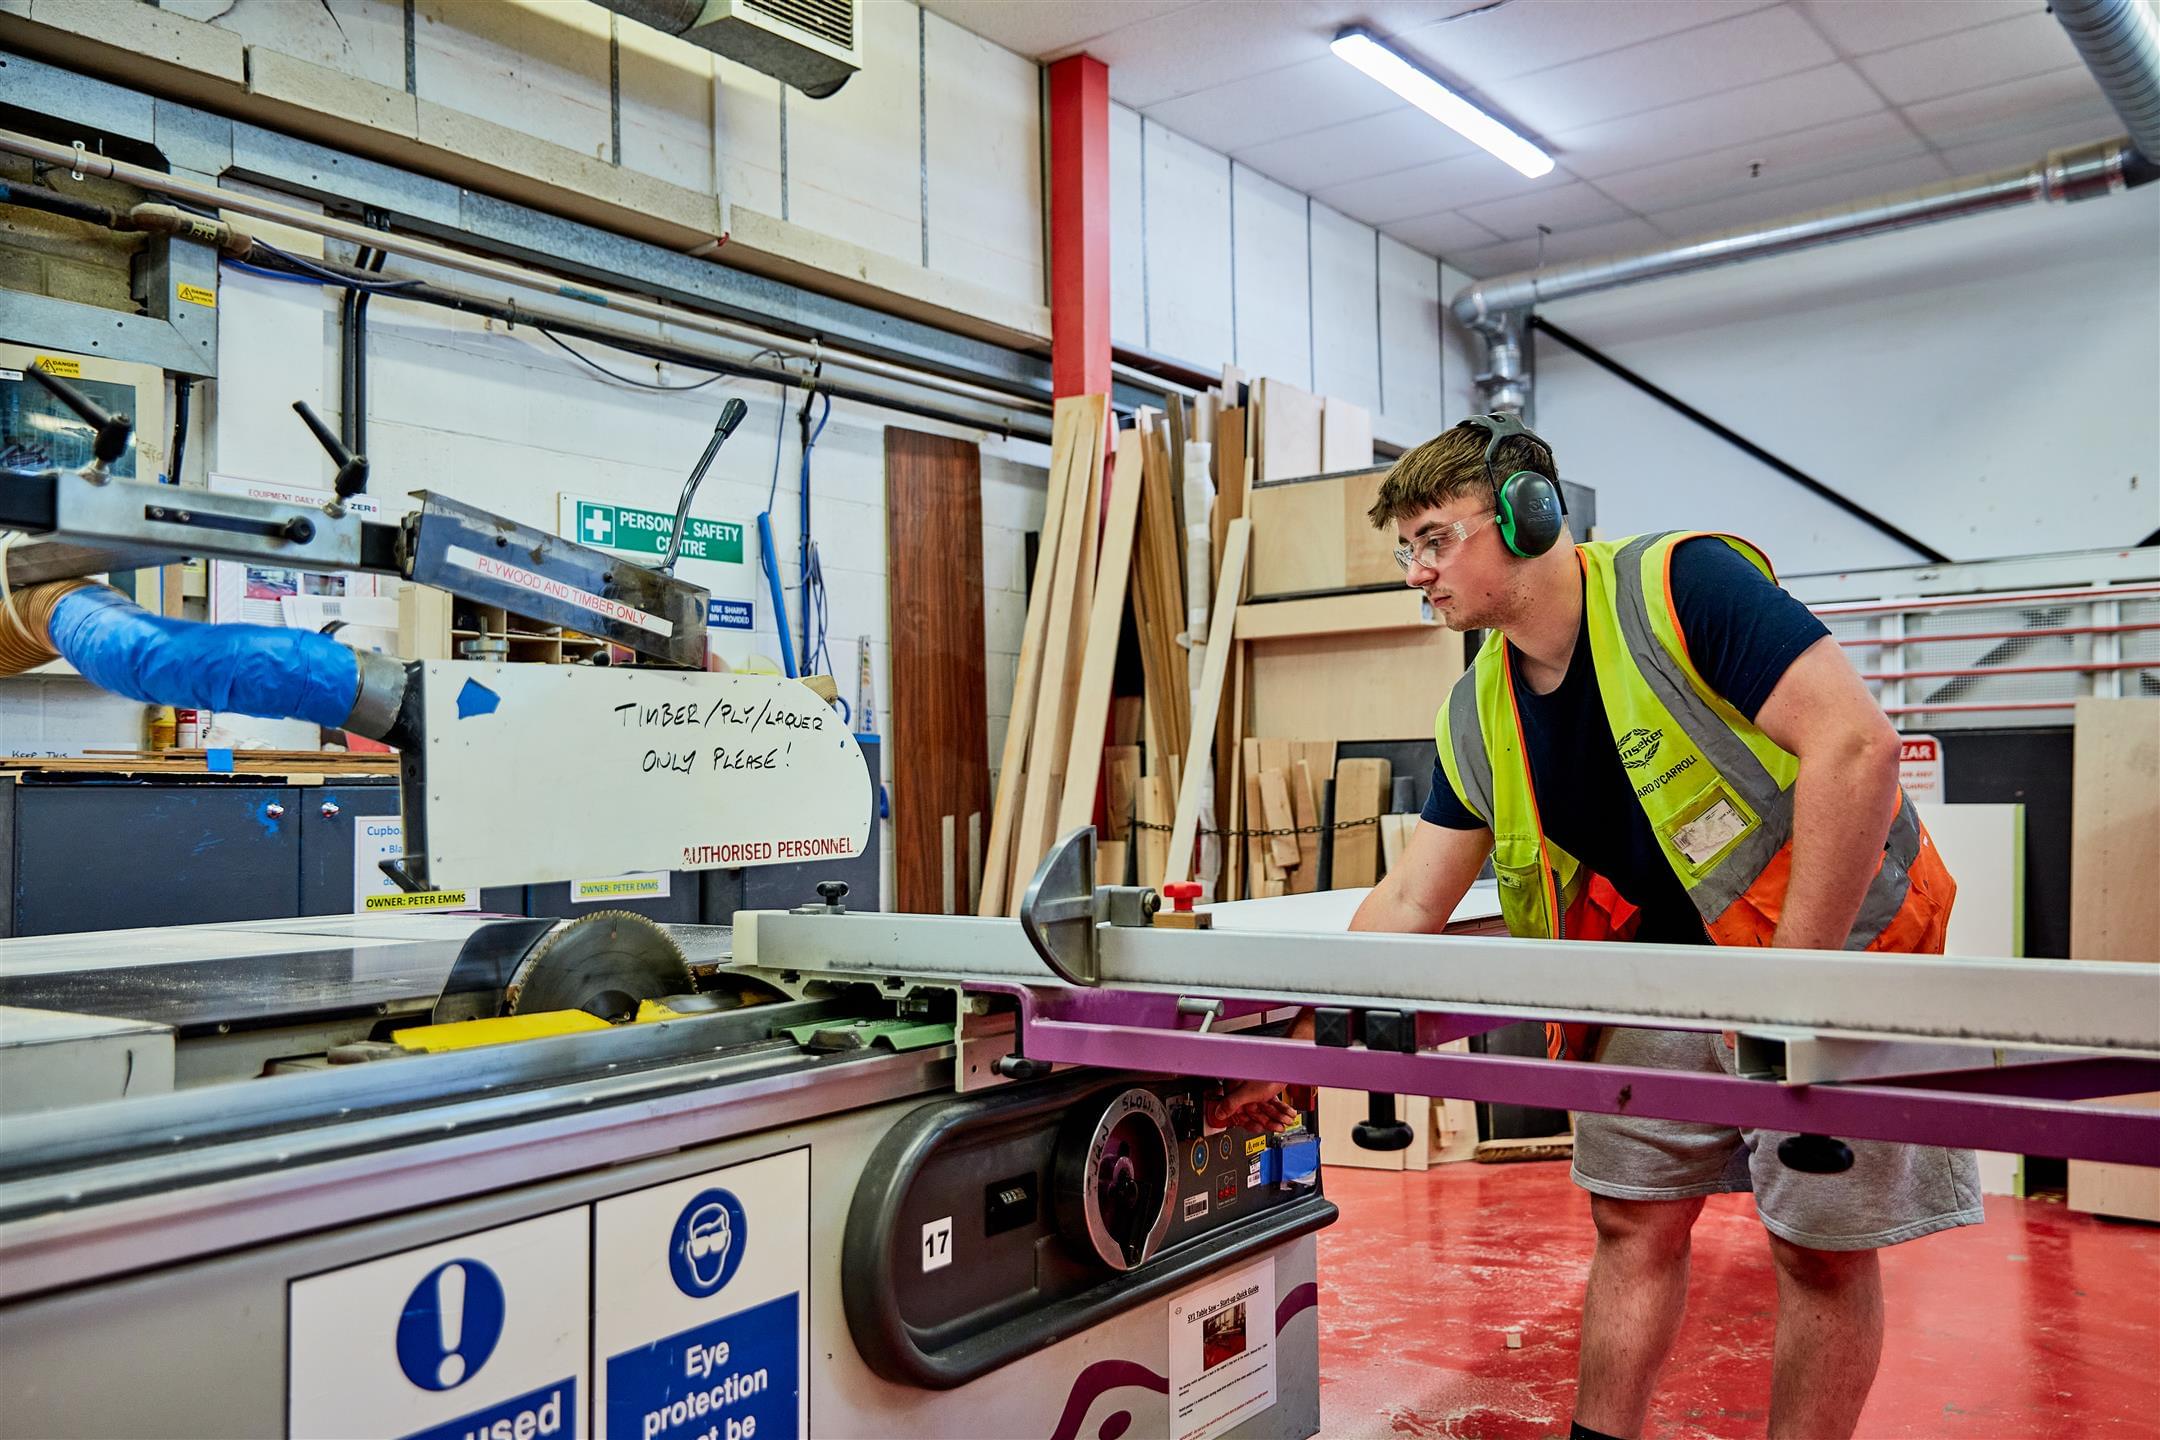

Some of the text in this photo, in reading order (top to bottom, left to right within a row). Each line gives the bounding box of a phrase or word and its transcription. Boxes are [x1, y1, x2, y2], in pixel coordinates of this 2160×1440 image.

[191, 228, 215, 241] GAS
[52, 360, 79, 368] DANGER
[248, 488, 292, 501] EQUIPMENT
[295, 495, 315, 505] DAILY
[619, 511, 739, 541] PERSON SAFETY
[478, 556, 647, 626] PLYWOOD AND TIMBER ONLY
[709, 613, 750, 624] BIN PROVIDED
[711, 604, 747, 615] USE SHARPS
[642, 749, 697, 774] ONLY
[1655, 754, 1698, 789] O'CARROLL
[367, 825, 403, 838] Cupbo
[682, 836, 853, 865] AUTHORISED PERSONNEL
[613, 881, 635, 892] PETER
[637, 879, 659, 890] EMMS
[366, 893, 466, 908] OWNER: PETER EMMS
[925, 1228, 949, 1258] 17
[1196, 1307, 1208, 1319] Table
[1208, 1304, 1217, 1314] Saw
[1236, 1289, 1248, 1301] Quick
[1248, 1284, 1259, 1296] Guide
[686, 1341, 730, 1379] Eye
[644, 1367, 768, 1440] protection
[727, 1415, 756, 1440] be
